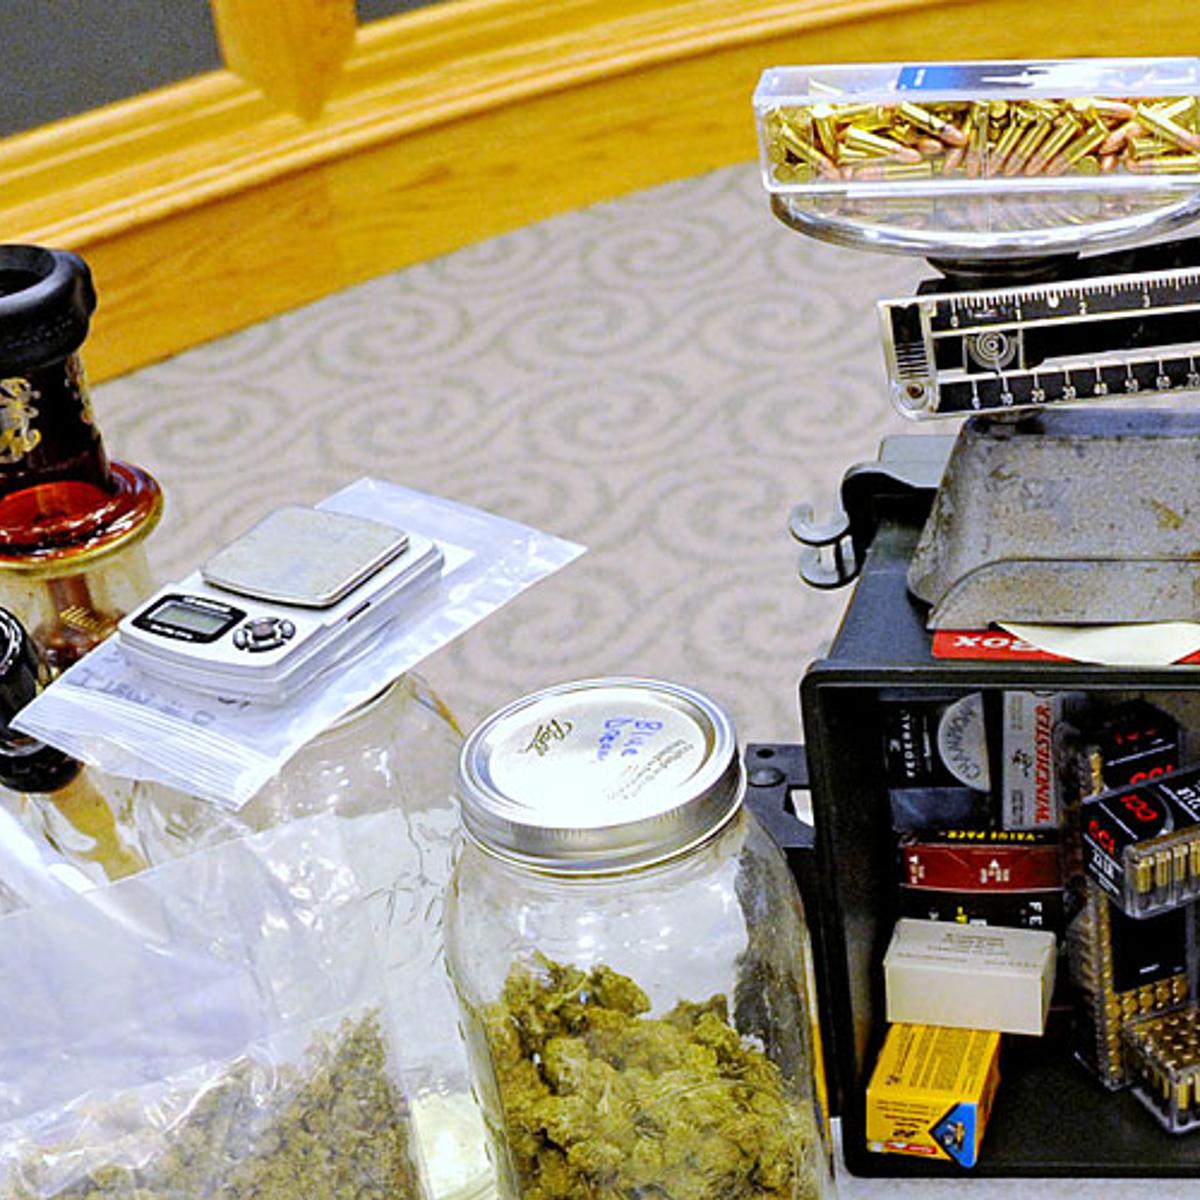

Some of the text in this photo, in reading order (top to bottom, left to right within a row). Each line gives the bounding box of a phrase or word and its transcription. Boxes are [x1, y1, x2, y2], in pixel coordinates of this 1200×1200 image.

[1031, 388, 1045, 402] 20
[1187, 372, 1200, 387] 70
[901, 712, 916, 779] FEDERAL
[1034, 704, 1053, 824] WINCHESTER
[1120, 794, 1158, 822] CCI
[947, 830, 986, 841] PACK
